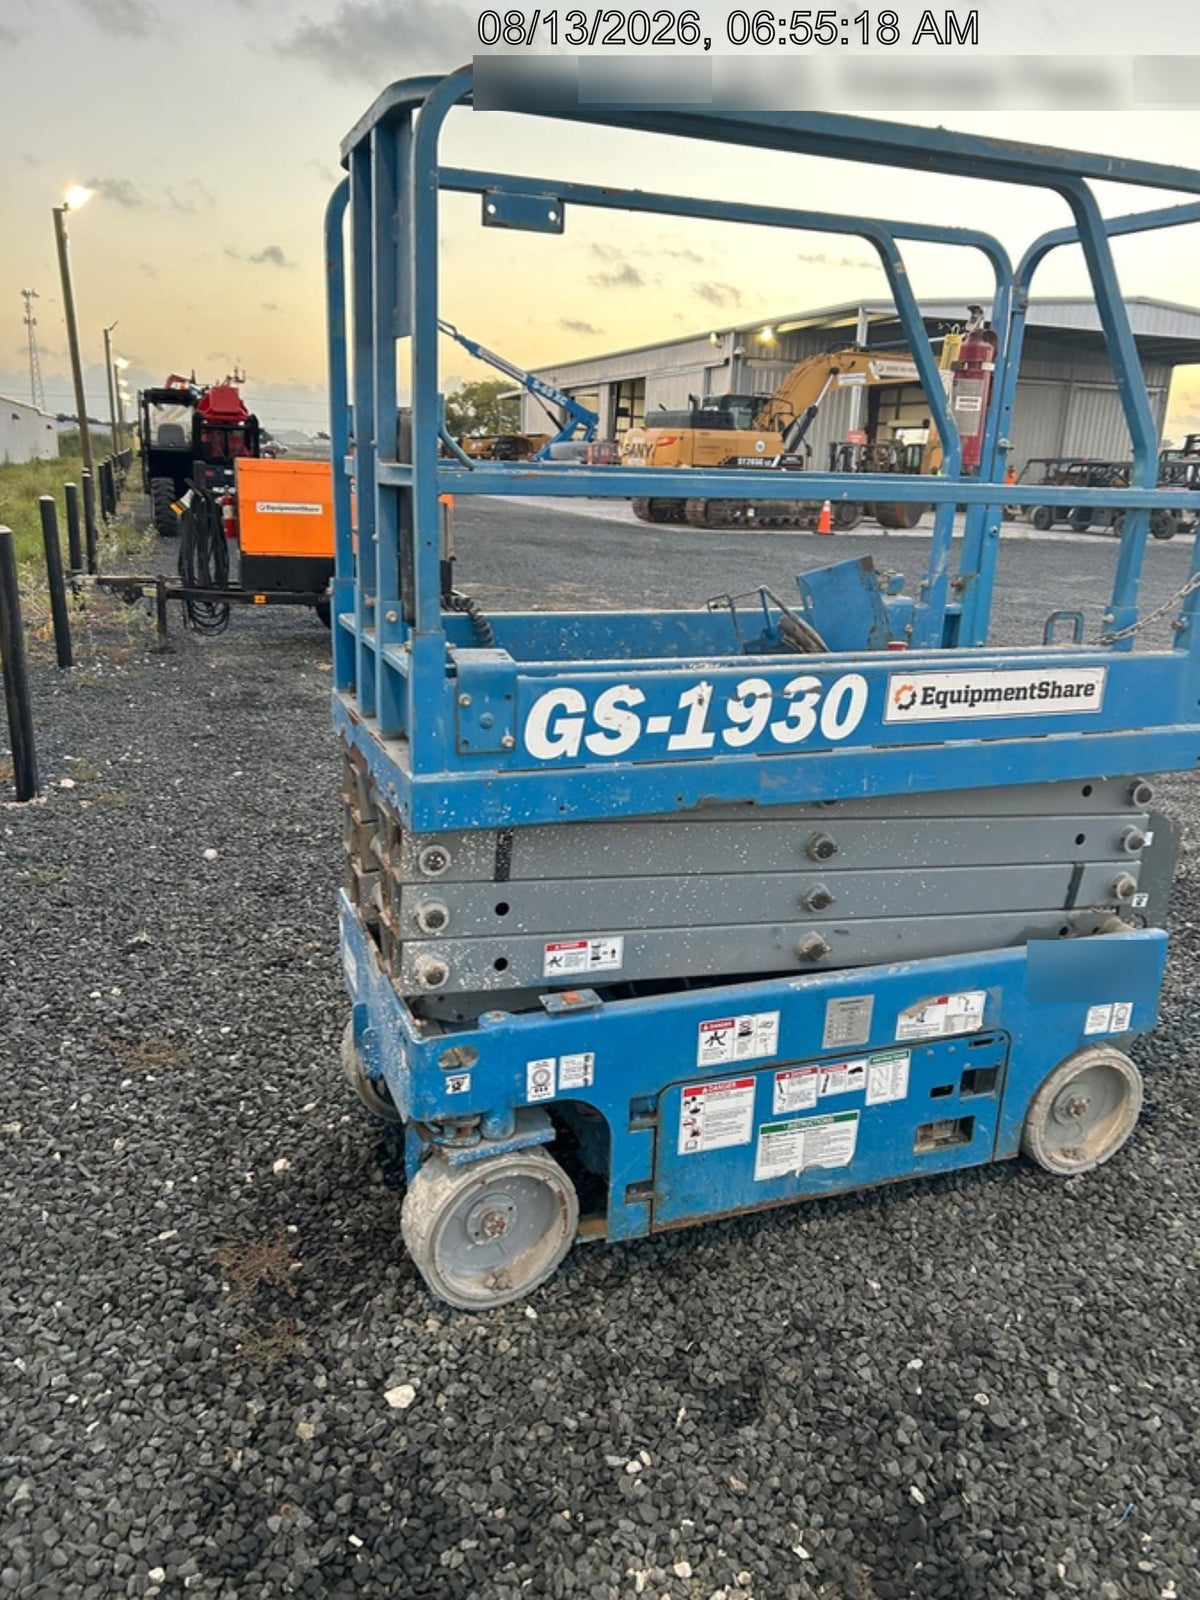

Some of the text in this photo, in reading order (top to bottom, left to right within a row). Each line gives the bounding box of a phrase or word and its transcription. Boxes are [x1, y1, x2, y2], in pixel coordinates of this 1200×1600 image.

[623, 443, 654, 458] SANY
[266, 504, 320, 513] EquipmentShare
[920, 681, 1096, 708] EquipmentShare
[523, 673, 869, 760] GS-1930
[708, 1081, 737, 1093] DANGER
